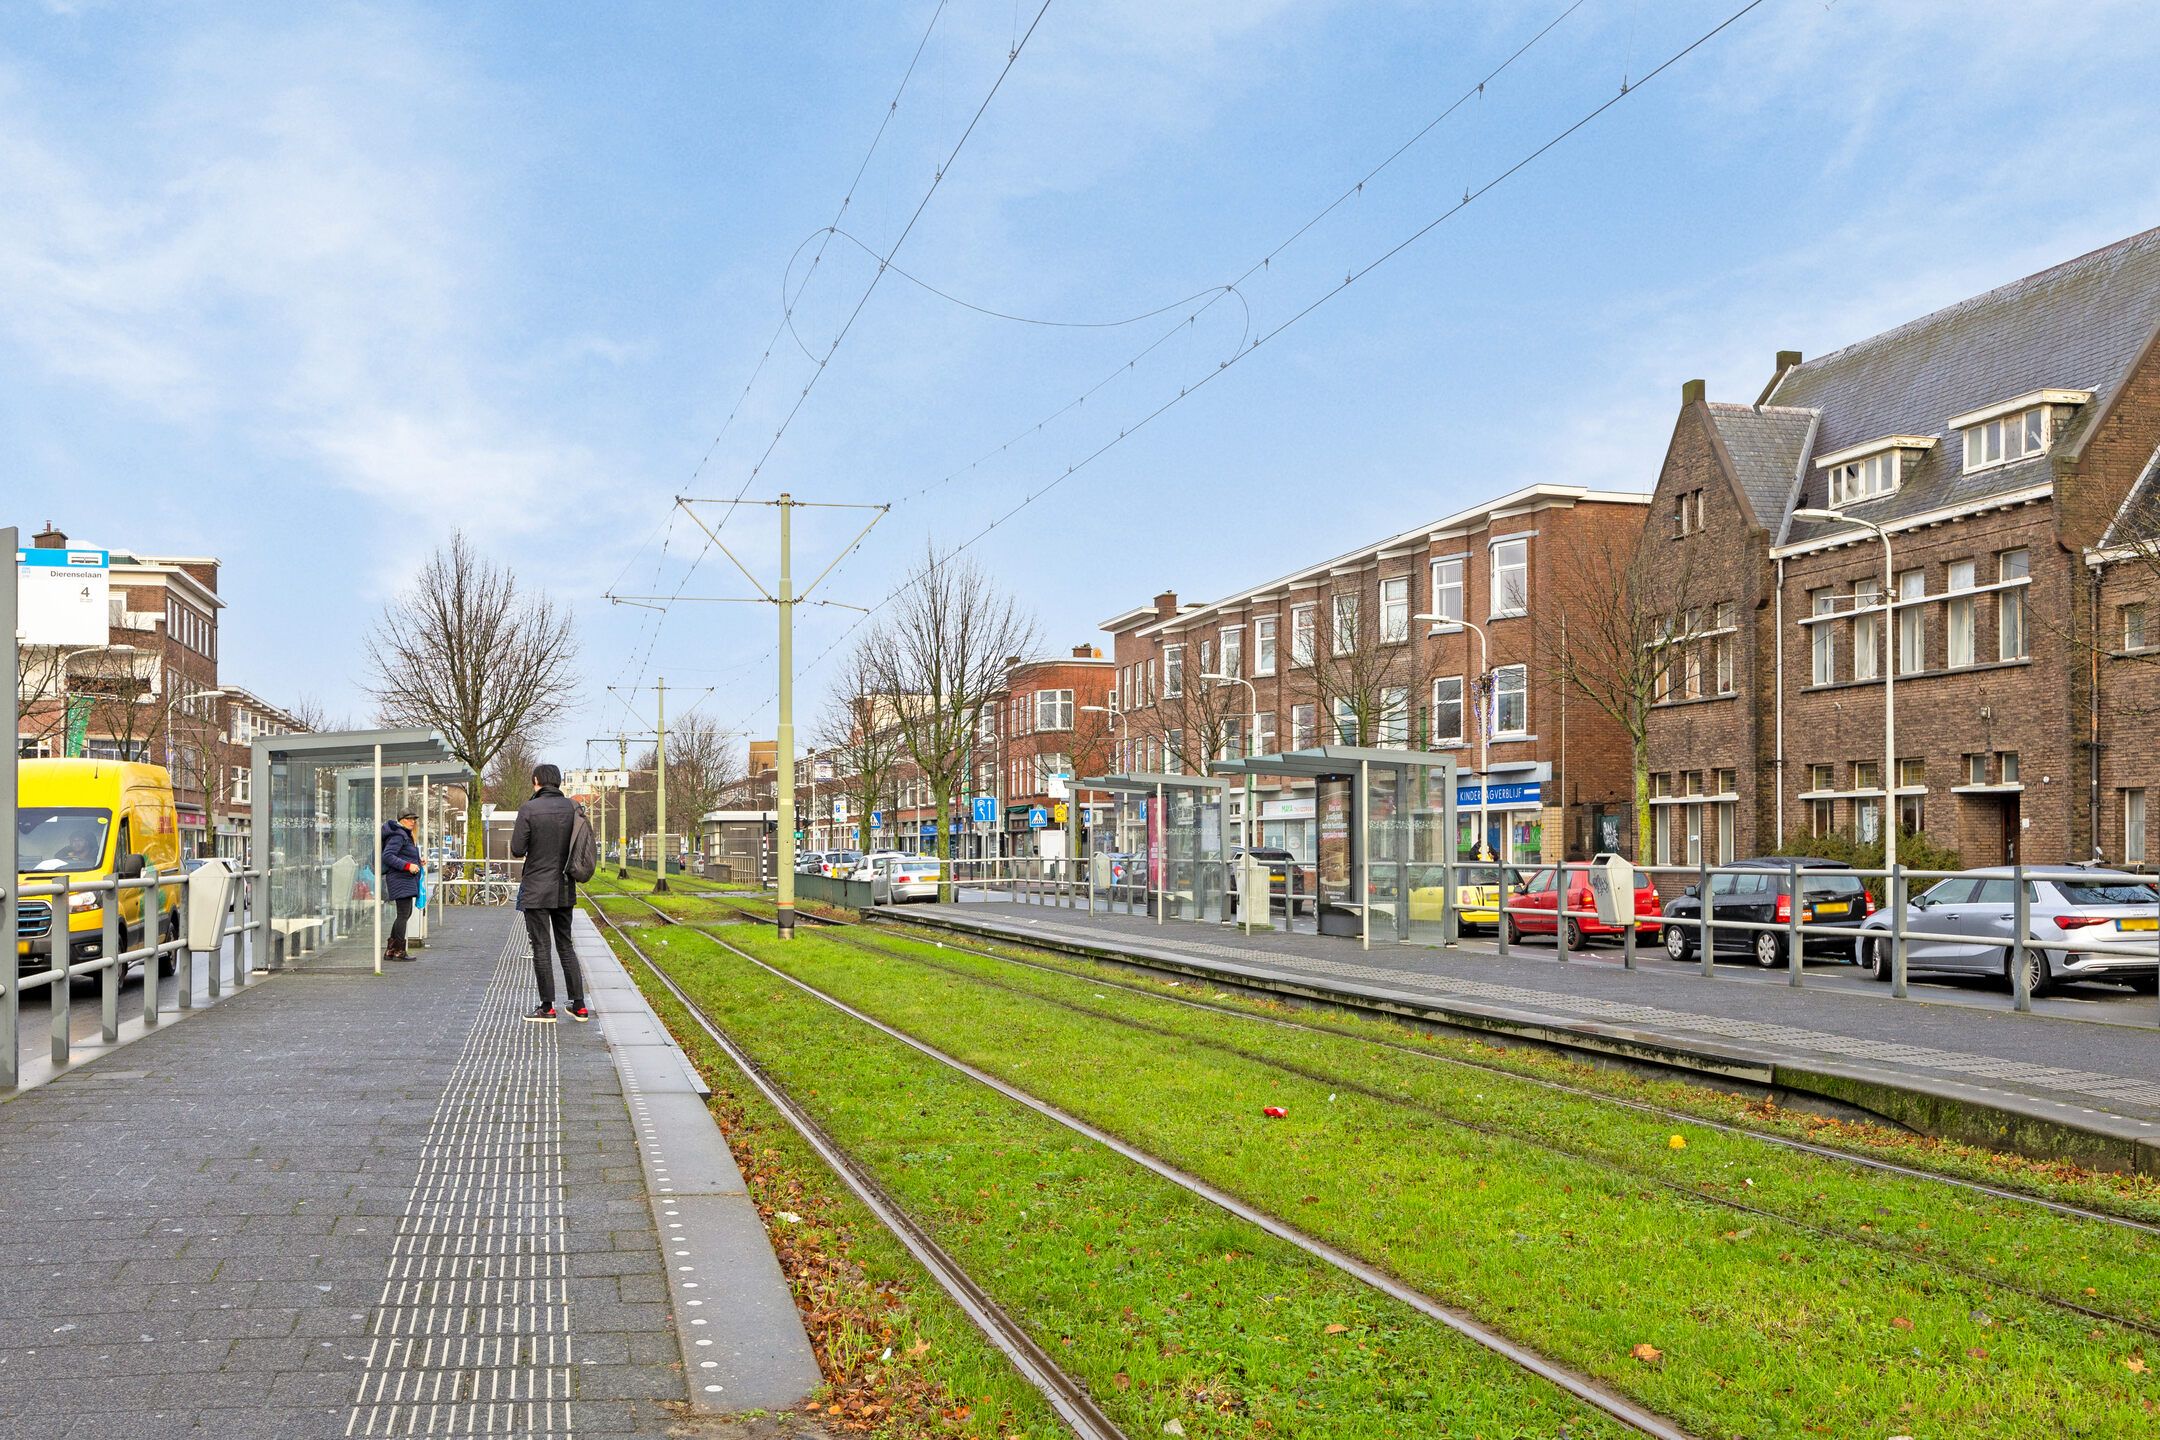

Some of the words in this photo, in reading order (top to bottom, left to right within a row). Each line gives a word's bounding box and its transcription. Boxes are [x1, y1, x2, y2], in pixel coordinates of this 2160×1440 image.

[50, 570, 102, 579] Dierenselaan
[80, 586, 91, 598] 4
[1459, 787, 1523, 801] KINDERAGVERBLIJF
